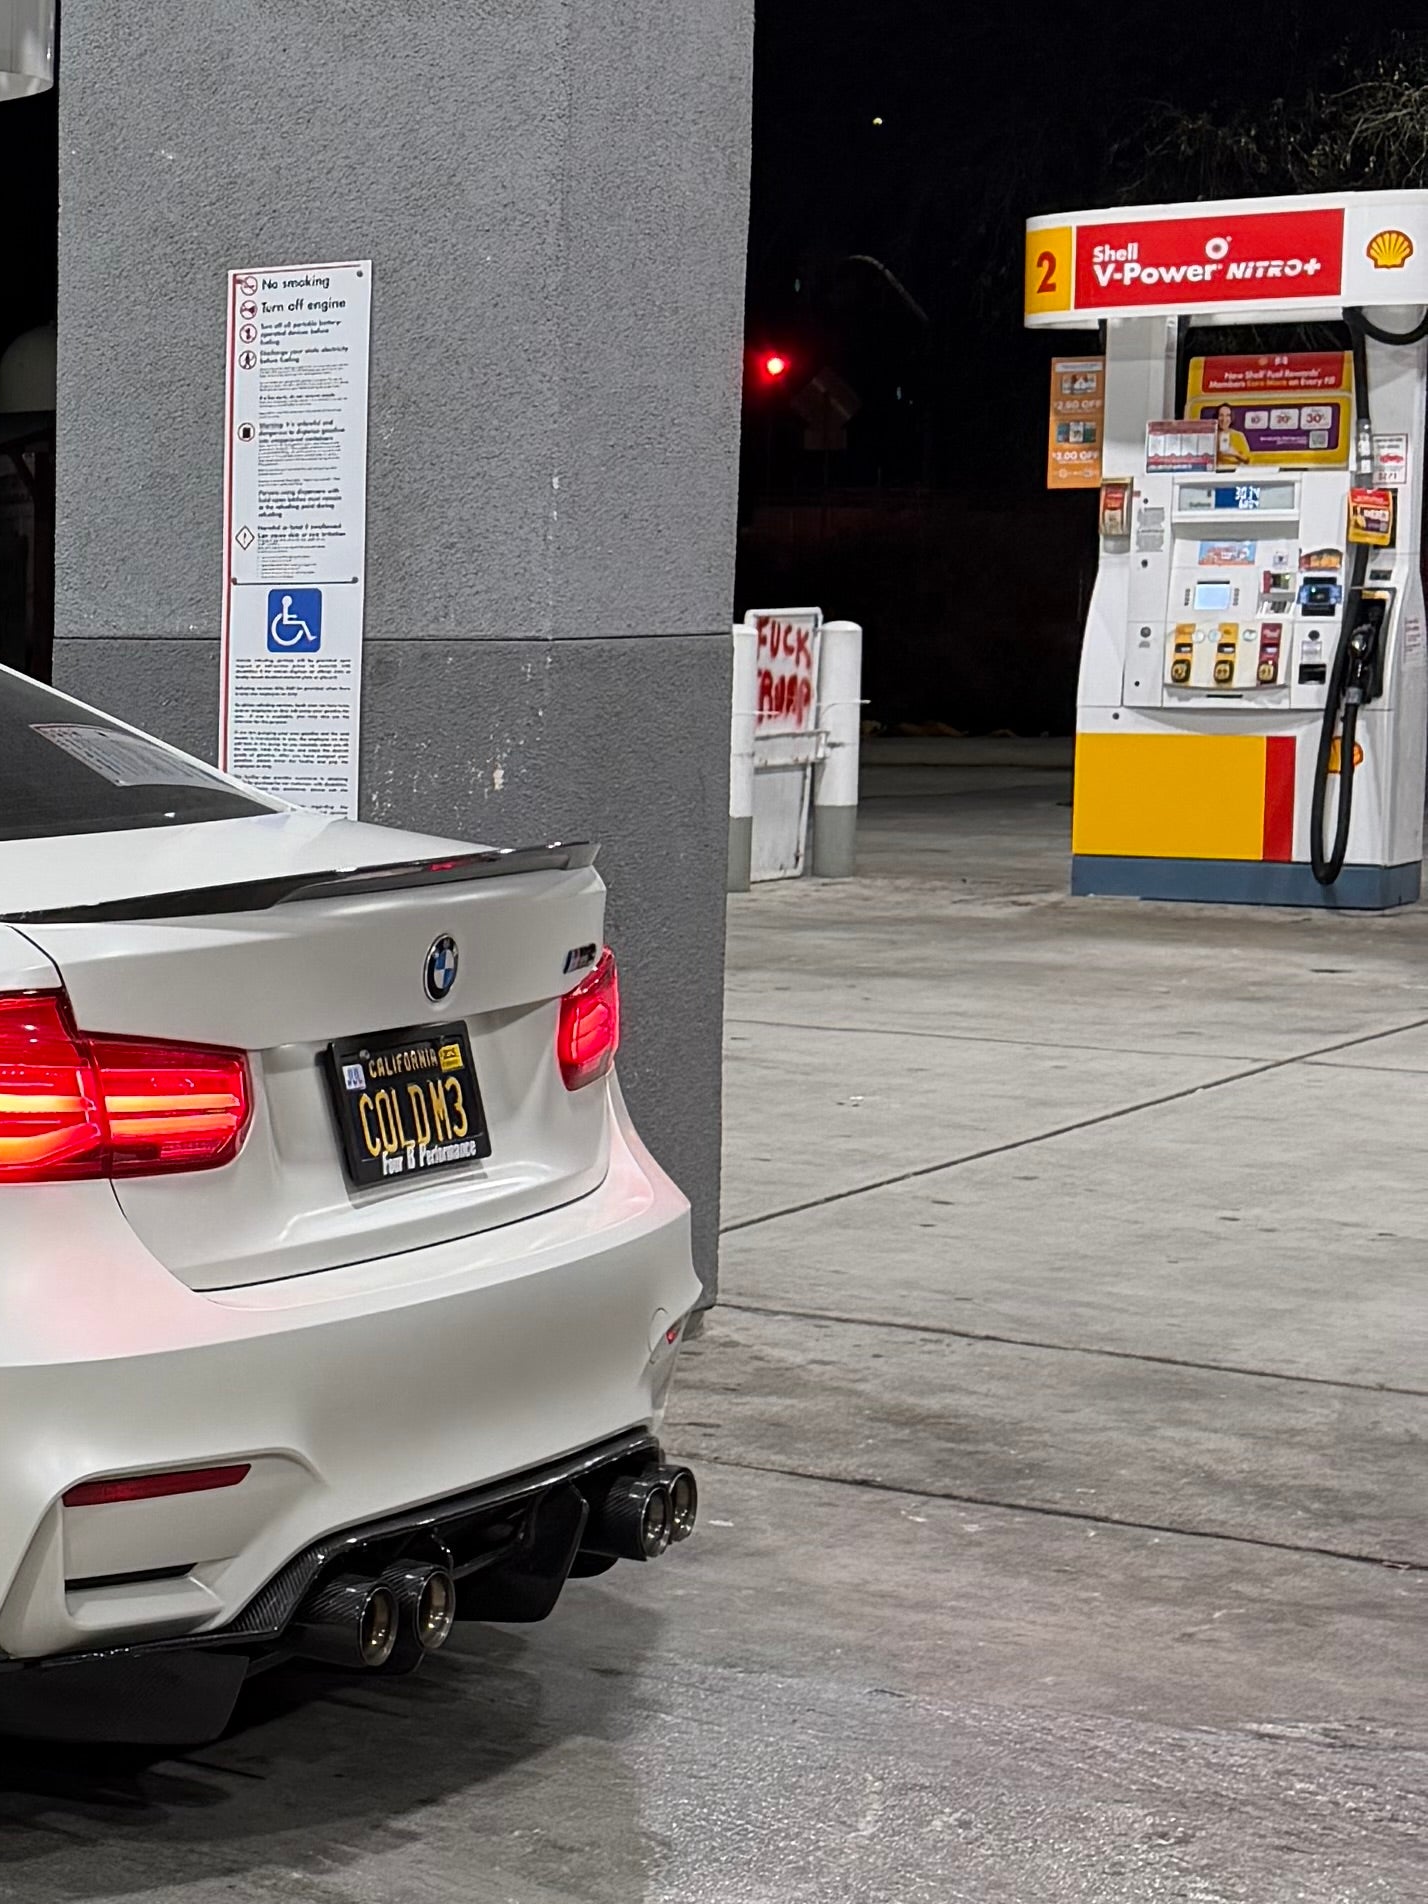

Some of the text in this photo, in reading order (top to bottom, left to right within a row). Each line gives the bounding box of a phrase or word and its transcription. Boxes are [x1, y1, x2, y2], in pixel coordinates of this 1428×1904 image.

[1093, 243, 1138, 263] Shell
[262, 275, 330, 290] No smoking
[1036, 251, 1057, 294] 2
[1093, 263, 1217, 287] V-Power
[261, 297, 345, 313] Turn off engine
[756, 616, 812, 670] FUCK
[756, 668, 812, 728] RUMP
[368, 1047, 439, 1078] CALIFORNIA
[359, 1076, 468, 1157] COLDM3
[419, 1140, 476, 1167] Performance
